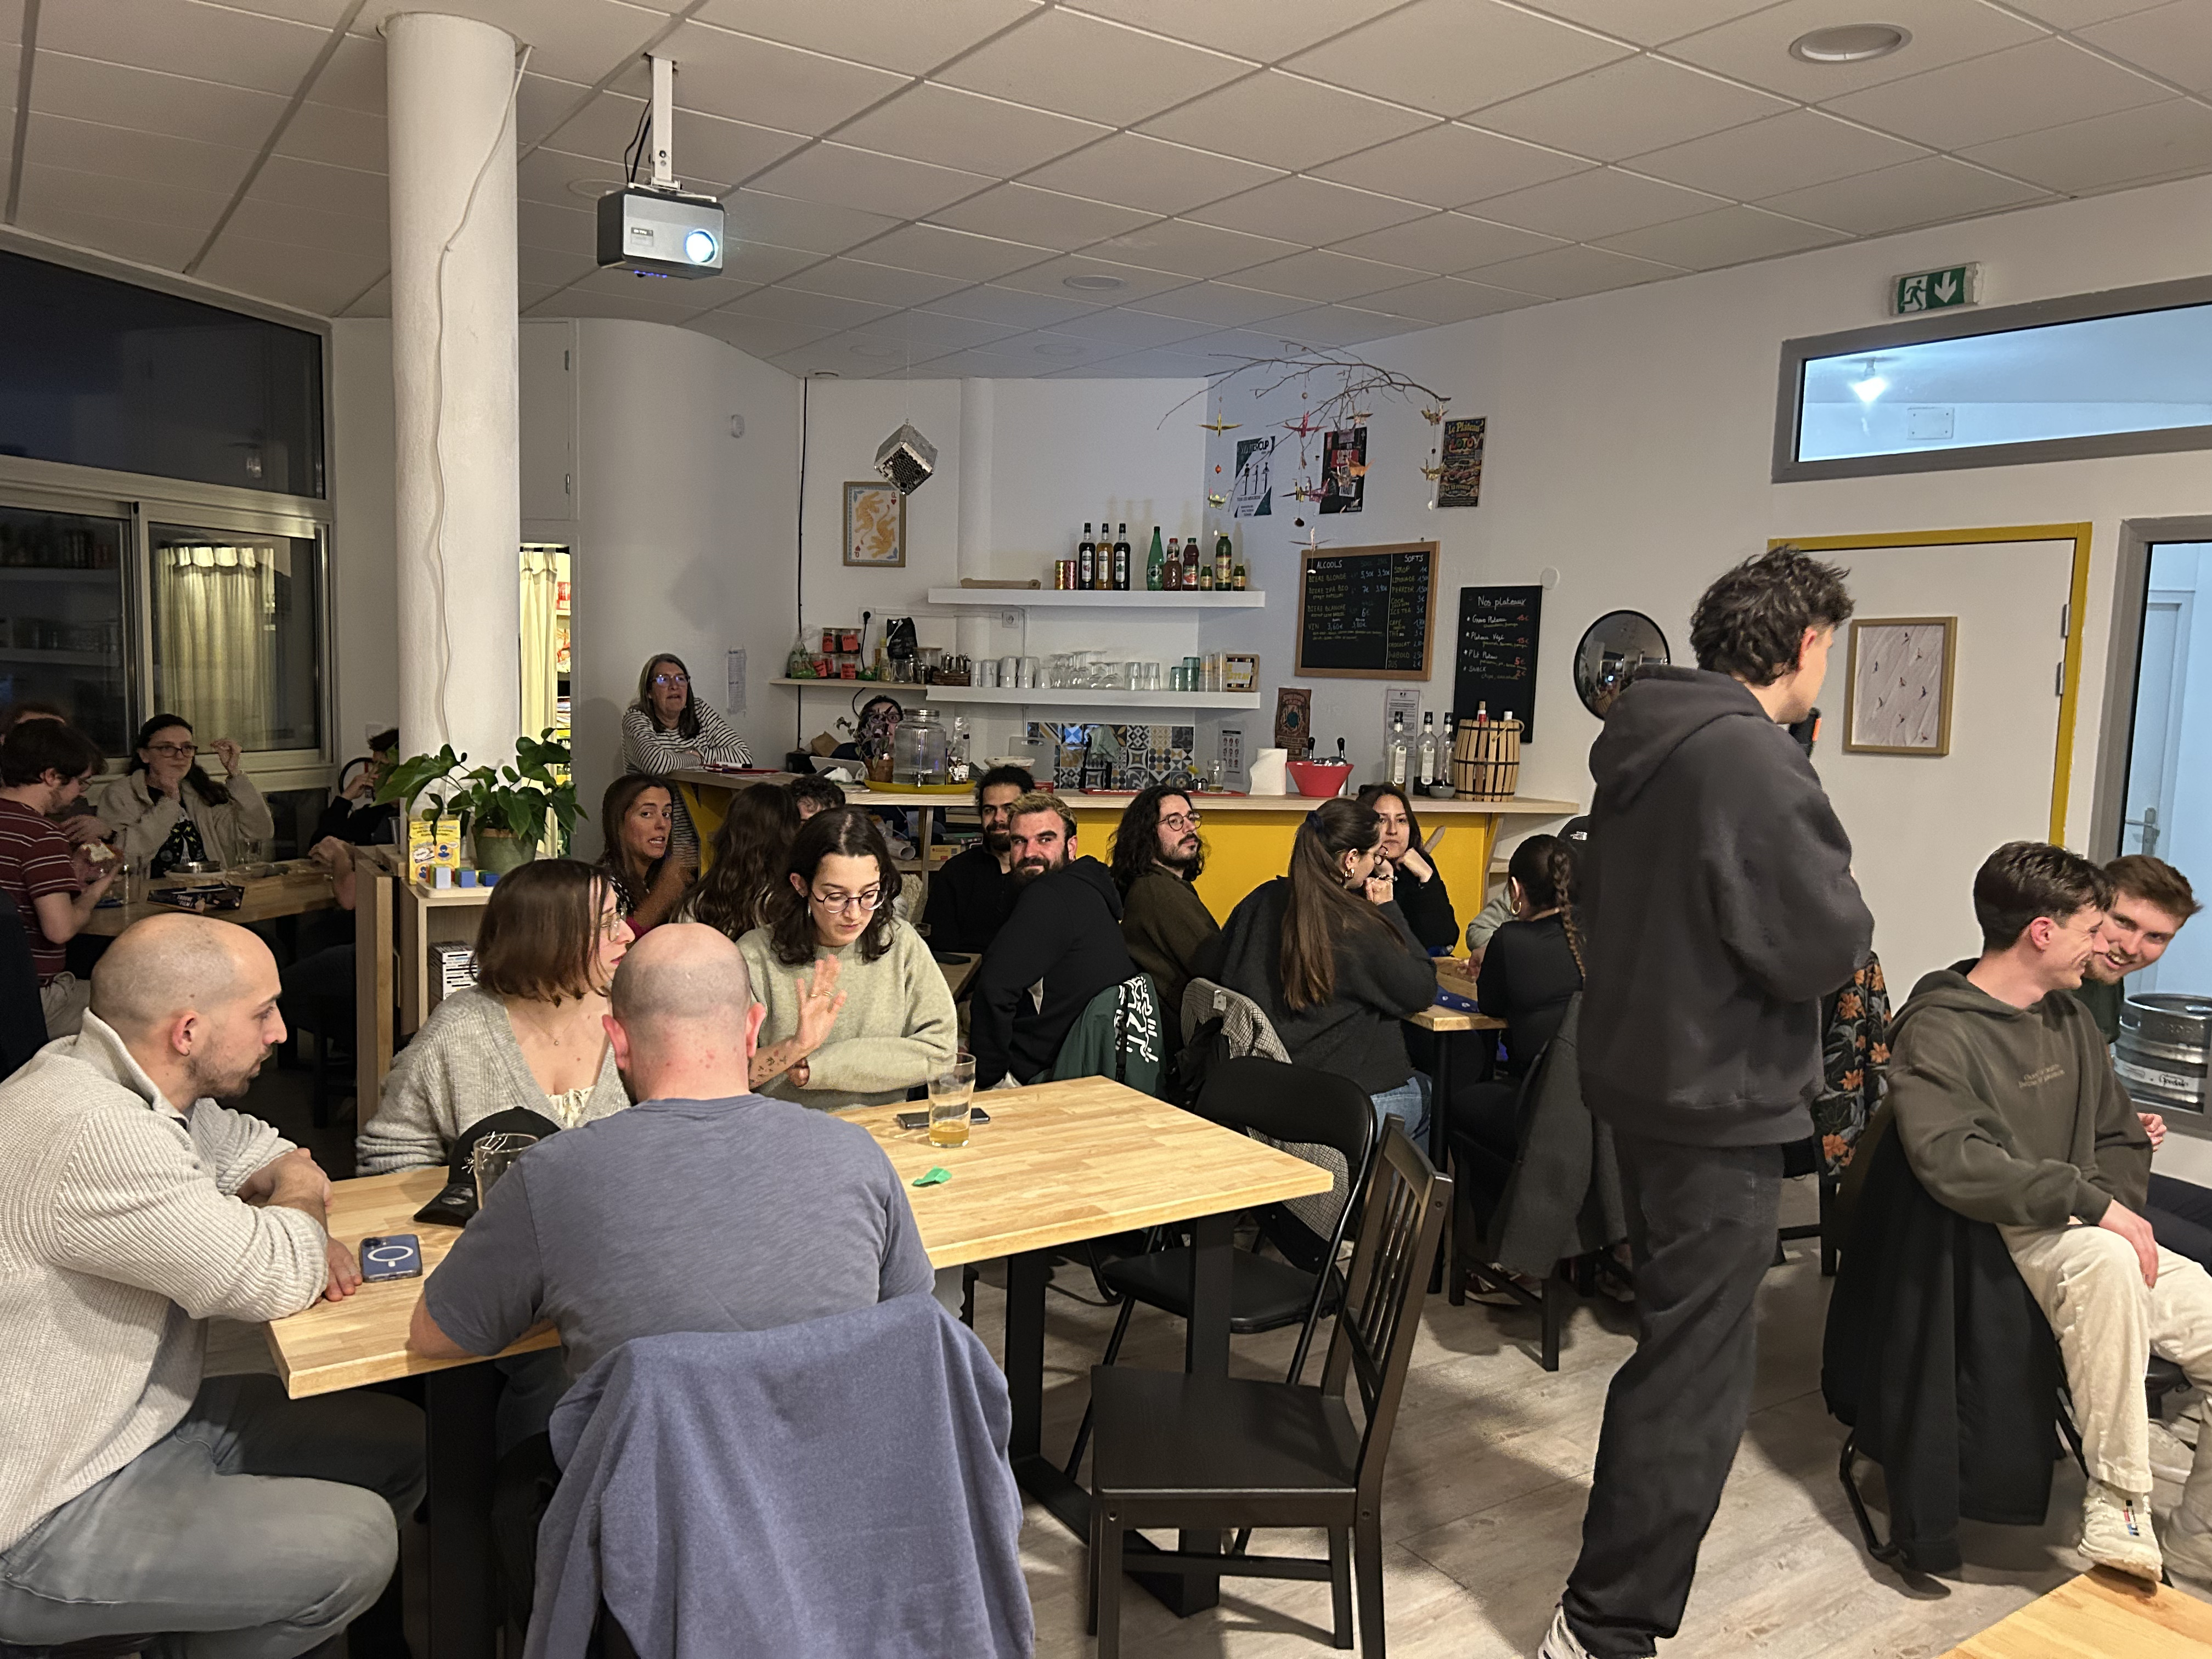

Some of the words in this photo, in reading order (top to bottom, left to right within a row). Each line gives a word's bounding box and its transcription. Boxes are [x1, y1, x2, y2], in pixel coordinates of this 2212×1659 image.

[1450, 437, 1474, 450] LOTO
[1404, 554, 1424, 563] SOFTS
[1317, 560, 1342, 569] ALCOOLS
[1327, 573, 1346, 582] BLONDE
[1478, 595, 1491, 606] Nos
[1494, 596, 1526, 611] plateaux
